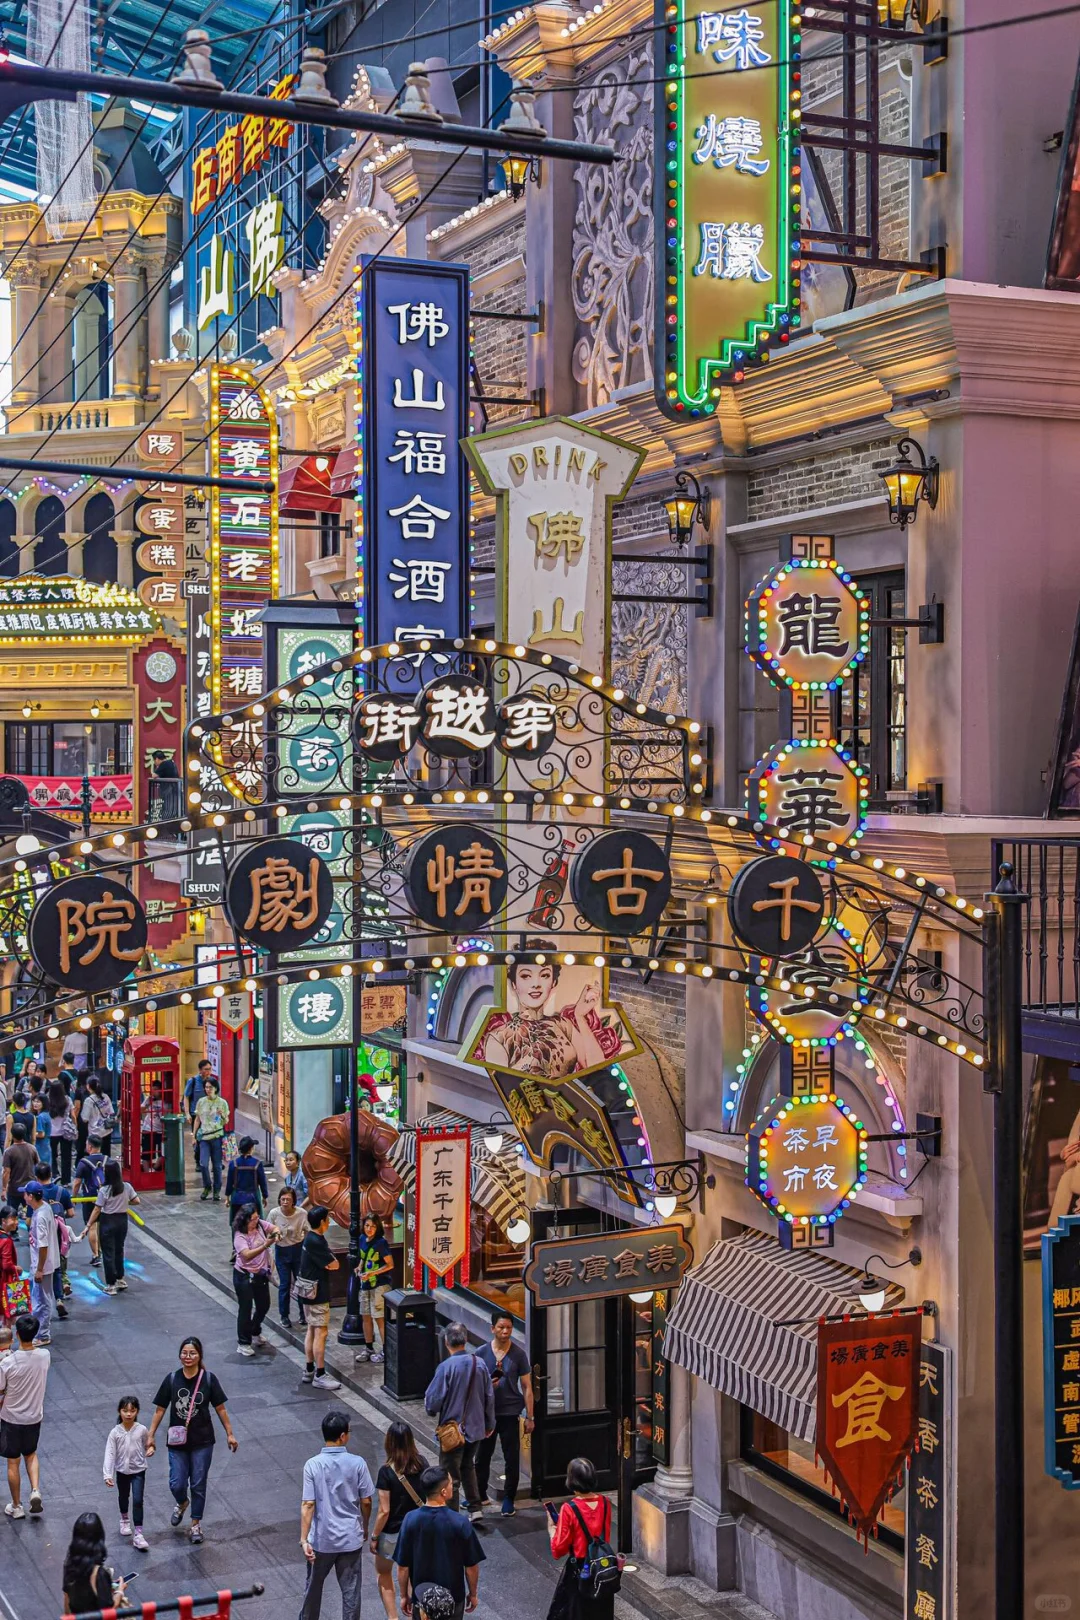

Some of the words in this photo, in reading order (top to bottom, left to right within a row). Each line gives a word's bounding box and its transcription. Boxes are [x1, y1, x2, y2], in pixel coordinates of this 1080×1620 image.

[694, 10, 773, 284] 味燒臘
[509, 444, 608, 483] DRINK
[188, 883, 221, 893] SHUN
[431, 1147, 454, 1254] 广东千古情
[831, 1371, 906, 1448] 食
